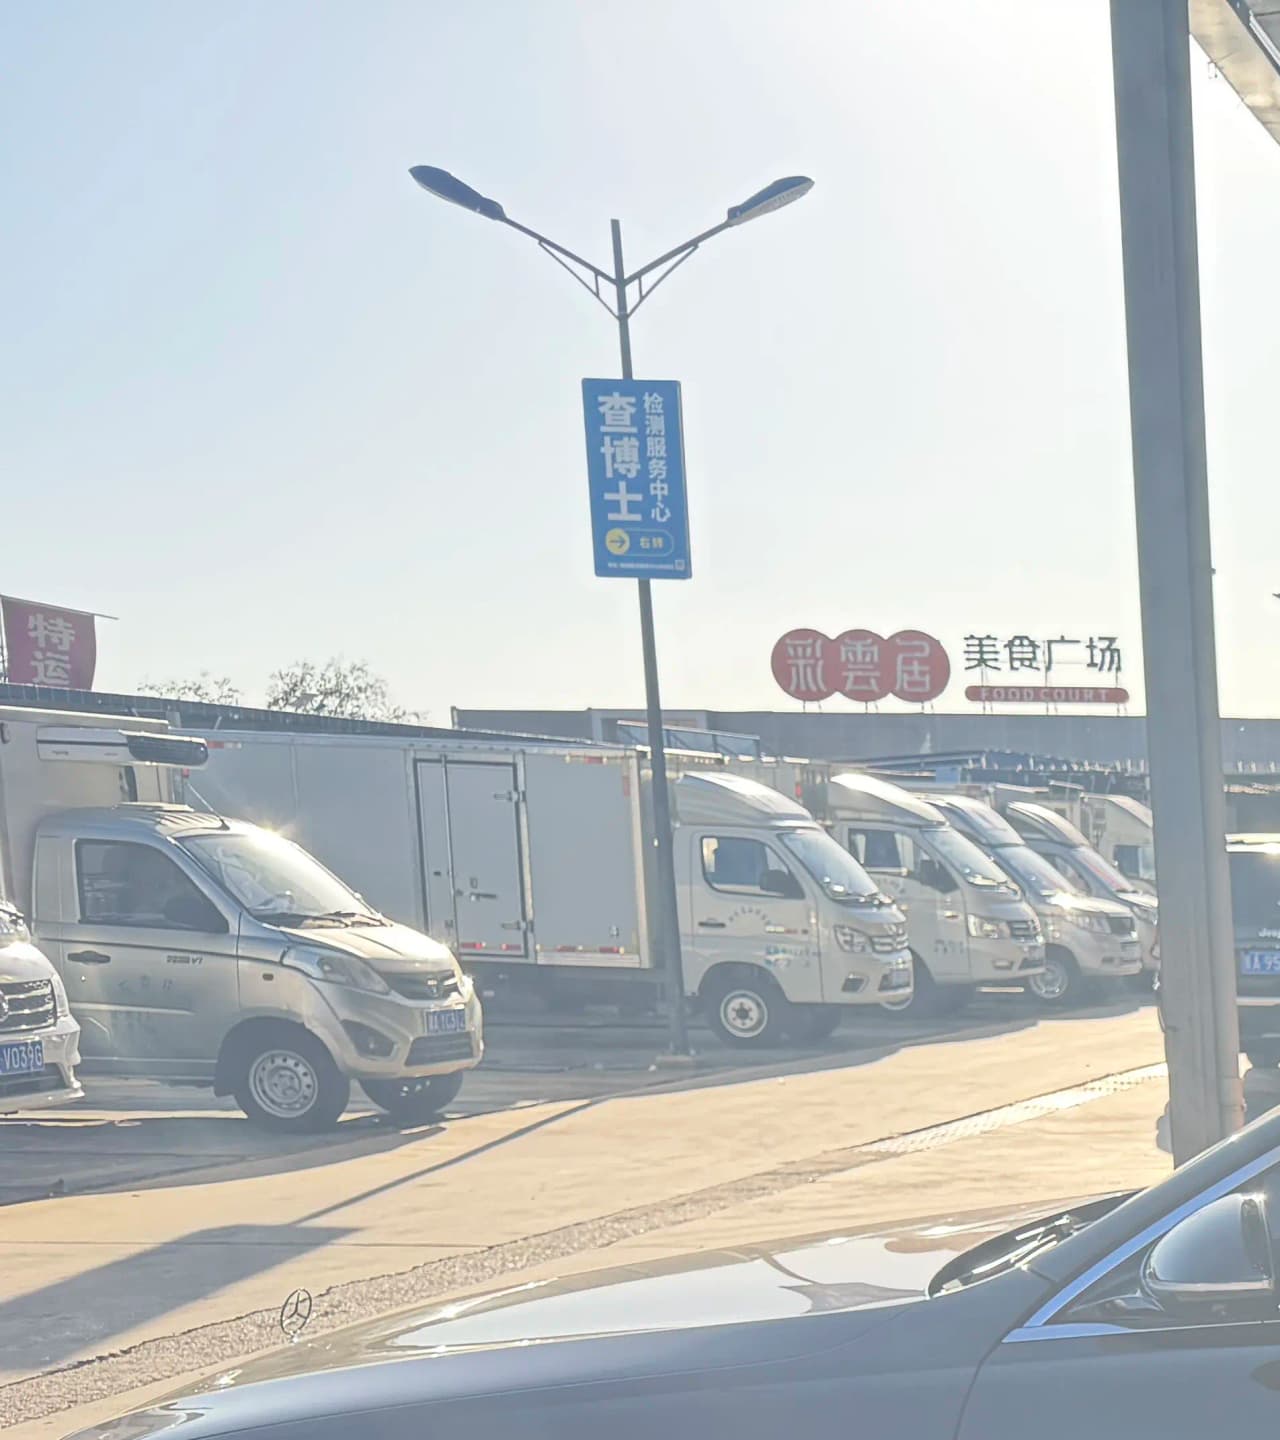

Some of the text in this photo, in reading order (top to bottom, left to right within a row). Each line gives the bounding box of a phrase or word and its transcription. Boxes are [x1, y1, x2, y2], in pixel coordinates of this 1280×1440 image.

[597, 391, 643, 522] 查博士
[643, 392, 672, 523] 检测服务中心
[27, 613, 76, 685] 特运
[963, 634, 1122, 672] 美食广场
[980, 687, 1109, 701] FOOD COURT
